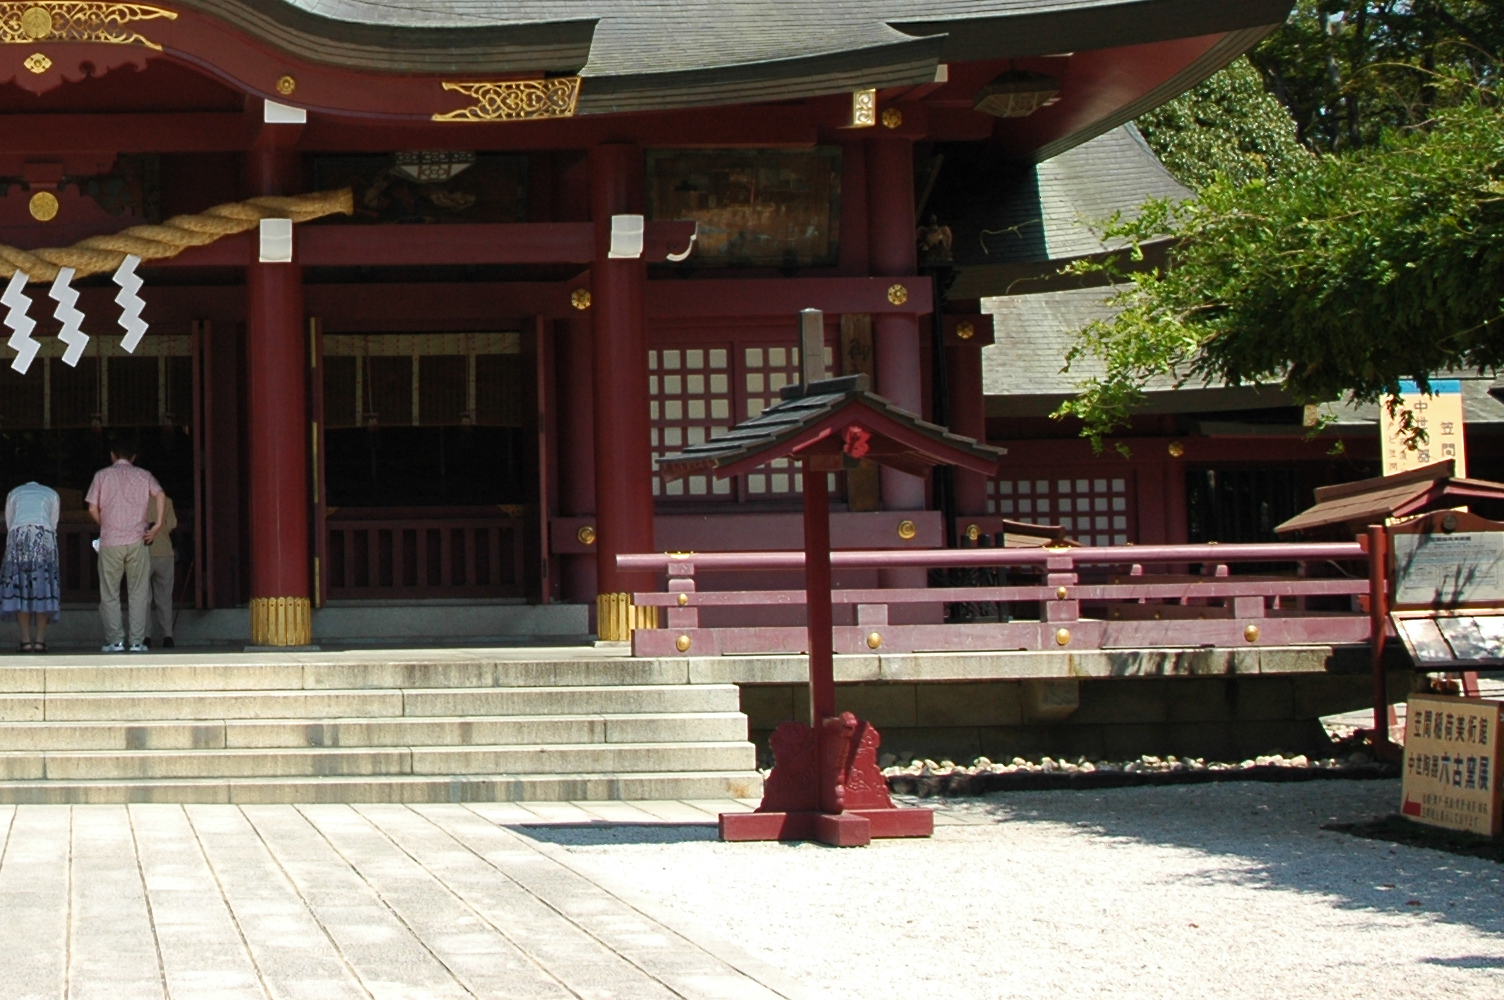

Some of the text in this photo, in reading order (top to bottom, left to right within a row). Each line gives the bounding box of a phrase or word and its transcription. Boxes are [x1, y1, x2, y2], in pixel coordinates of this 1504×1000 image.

[1413, 709, 1489, 746] 笠間稲荷美術館
